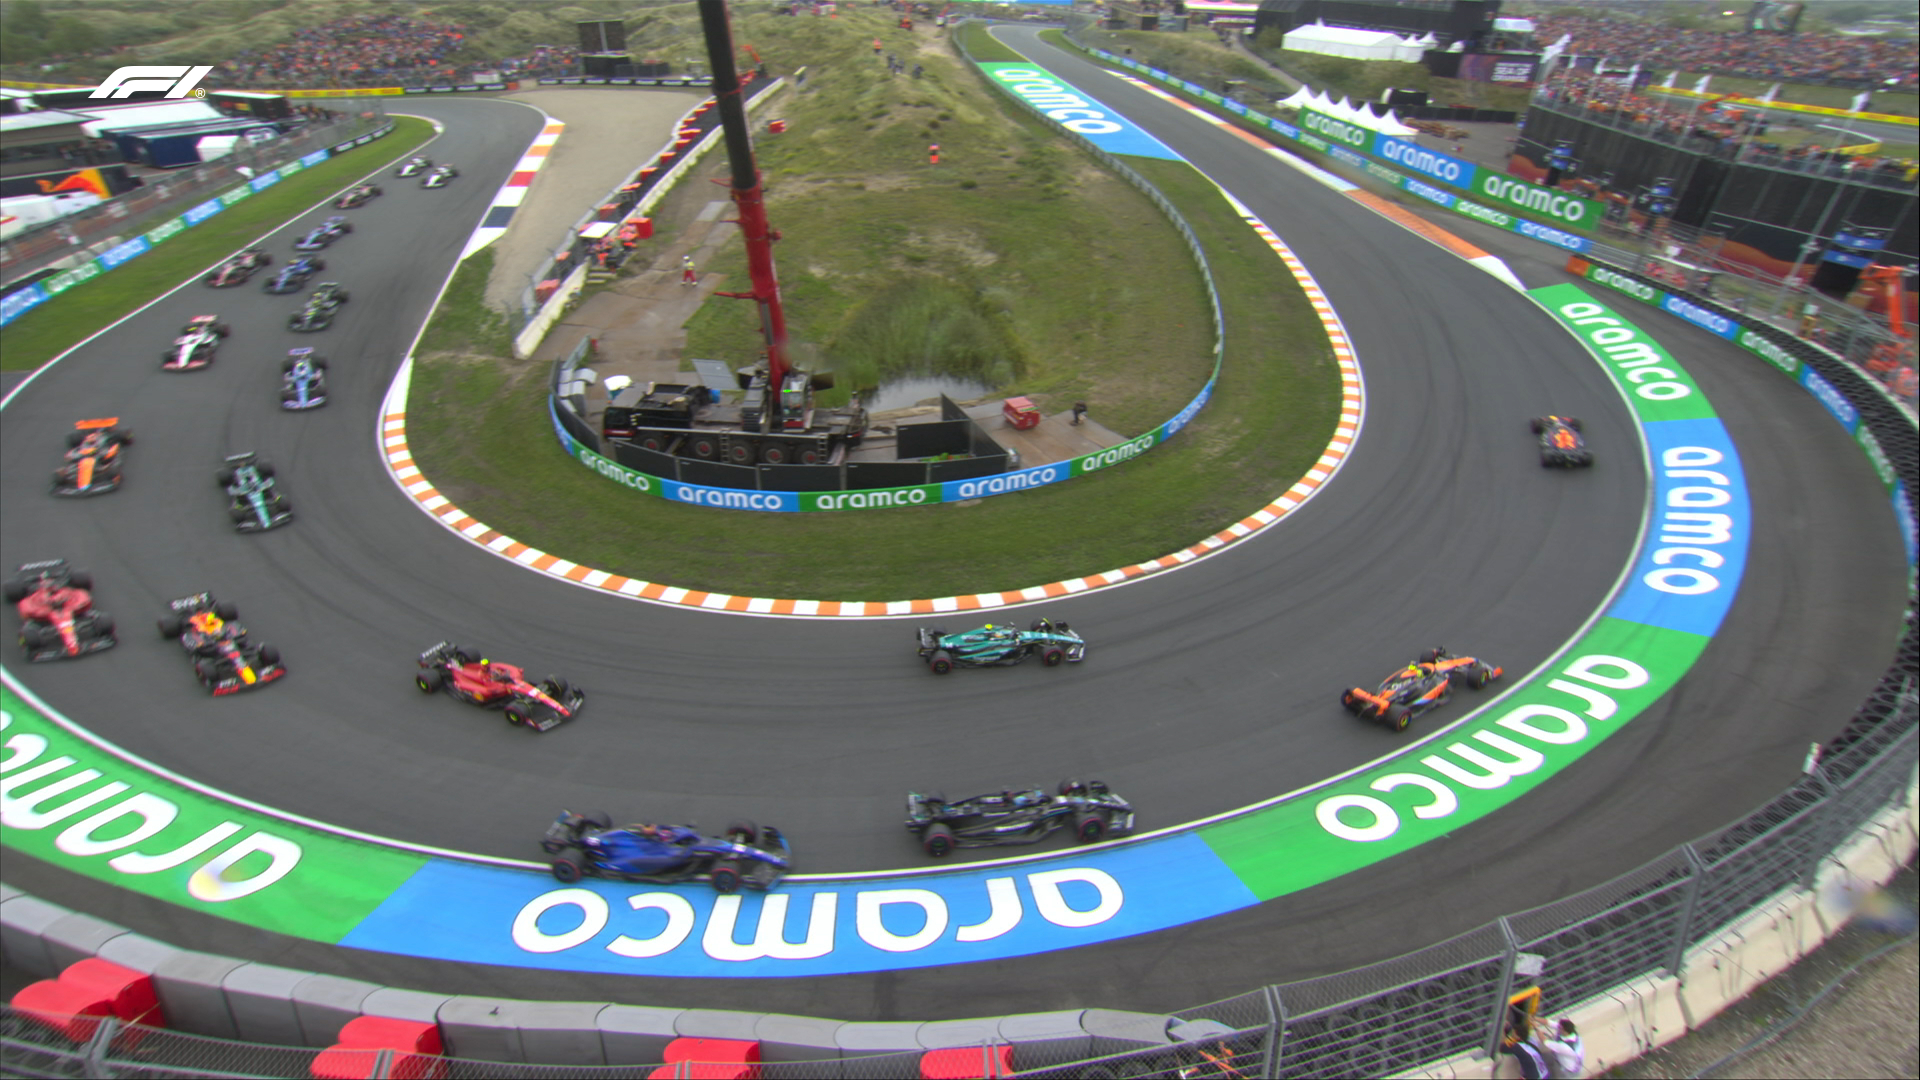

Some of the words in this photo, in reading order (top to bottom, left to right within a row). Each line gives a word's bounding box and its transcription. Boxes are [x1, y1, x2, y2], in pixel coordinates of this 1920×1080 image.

[993, 67, 1123, 134] aramco
[1305, 111, 1365, 146] aramco
[1383, 139, 1460, 181] aramco
[1407, 179, 1449, 204] aramco
[1484, 173, 1585, 222] aramco
[1457, 199, 1509, 227] aramco
[1520, 222, 1582, 249] aramco
[1593, 267, 1655, 301] aramco
[1667, 297, 1728, 333] aramco
[1560, 302, 1692, 401] aramco
[1741, 331, 1797, 373] aramco
[579, 450, 650, 491] aramco
[1082, 435, 1154, 471] aramco
[678, 486, 782, 511] aramco
[816, 488, 926, 510] aramco
[958, 468, 1056, 498] aramco
[1643, 446, 1733, 595] aramco
[1316, 654, 1651, 842] aramco
[511, 867, 1124, 962] aramco
